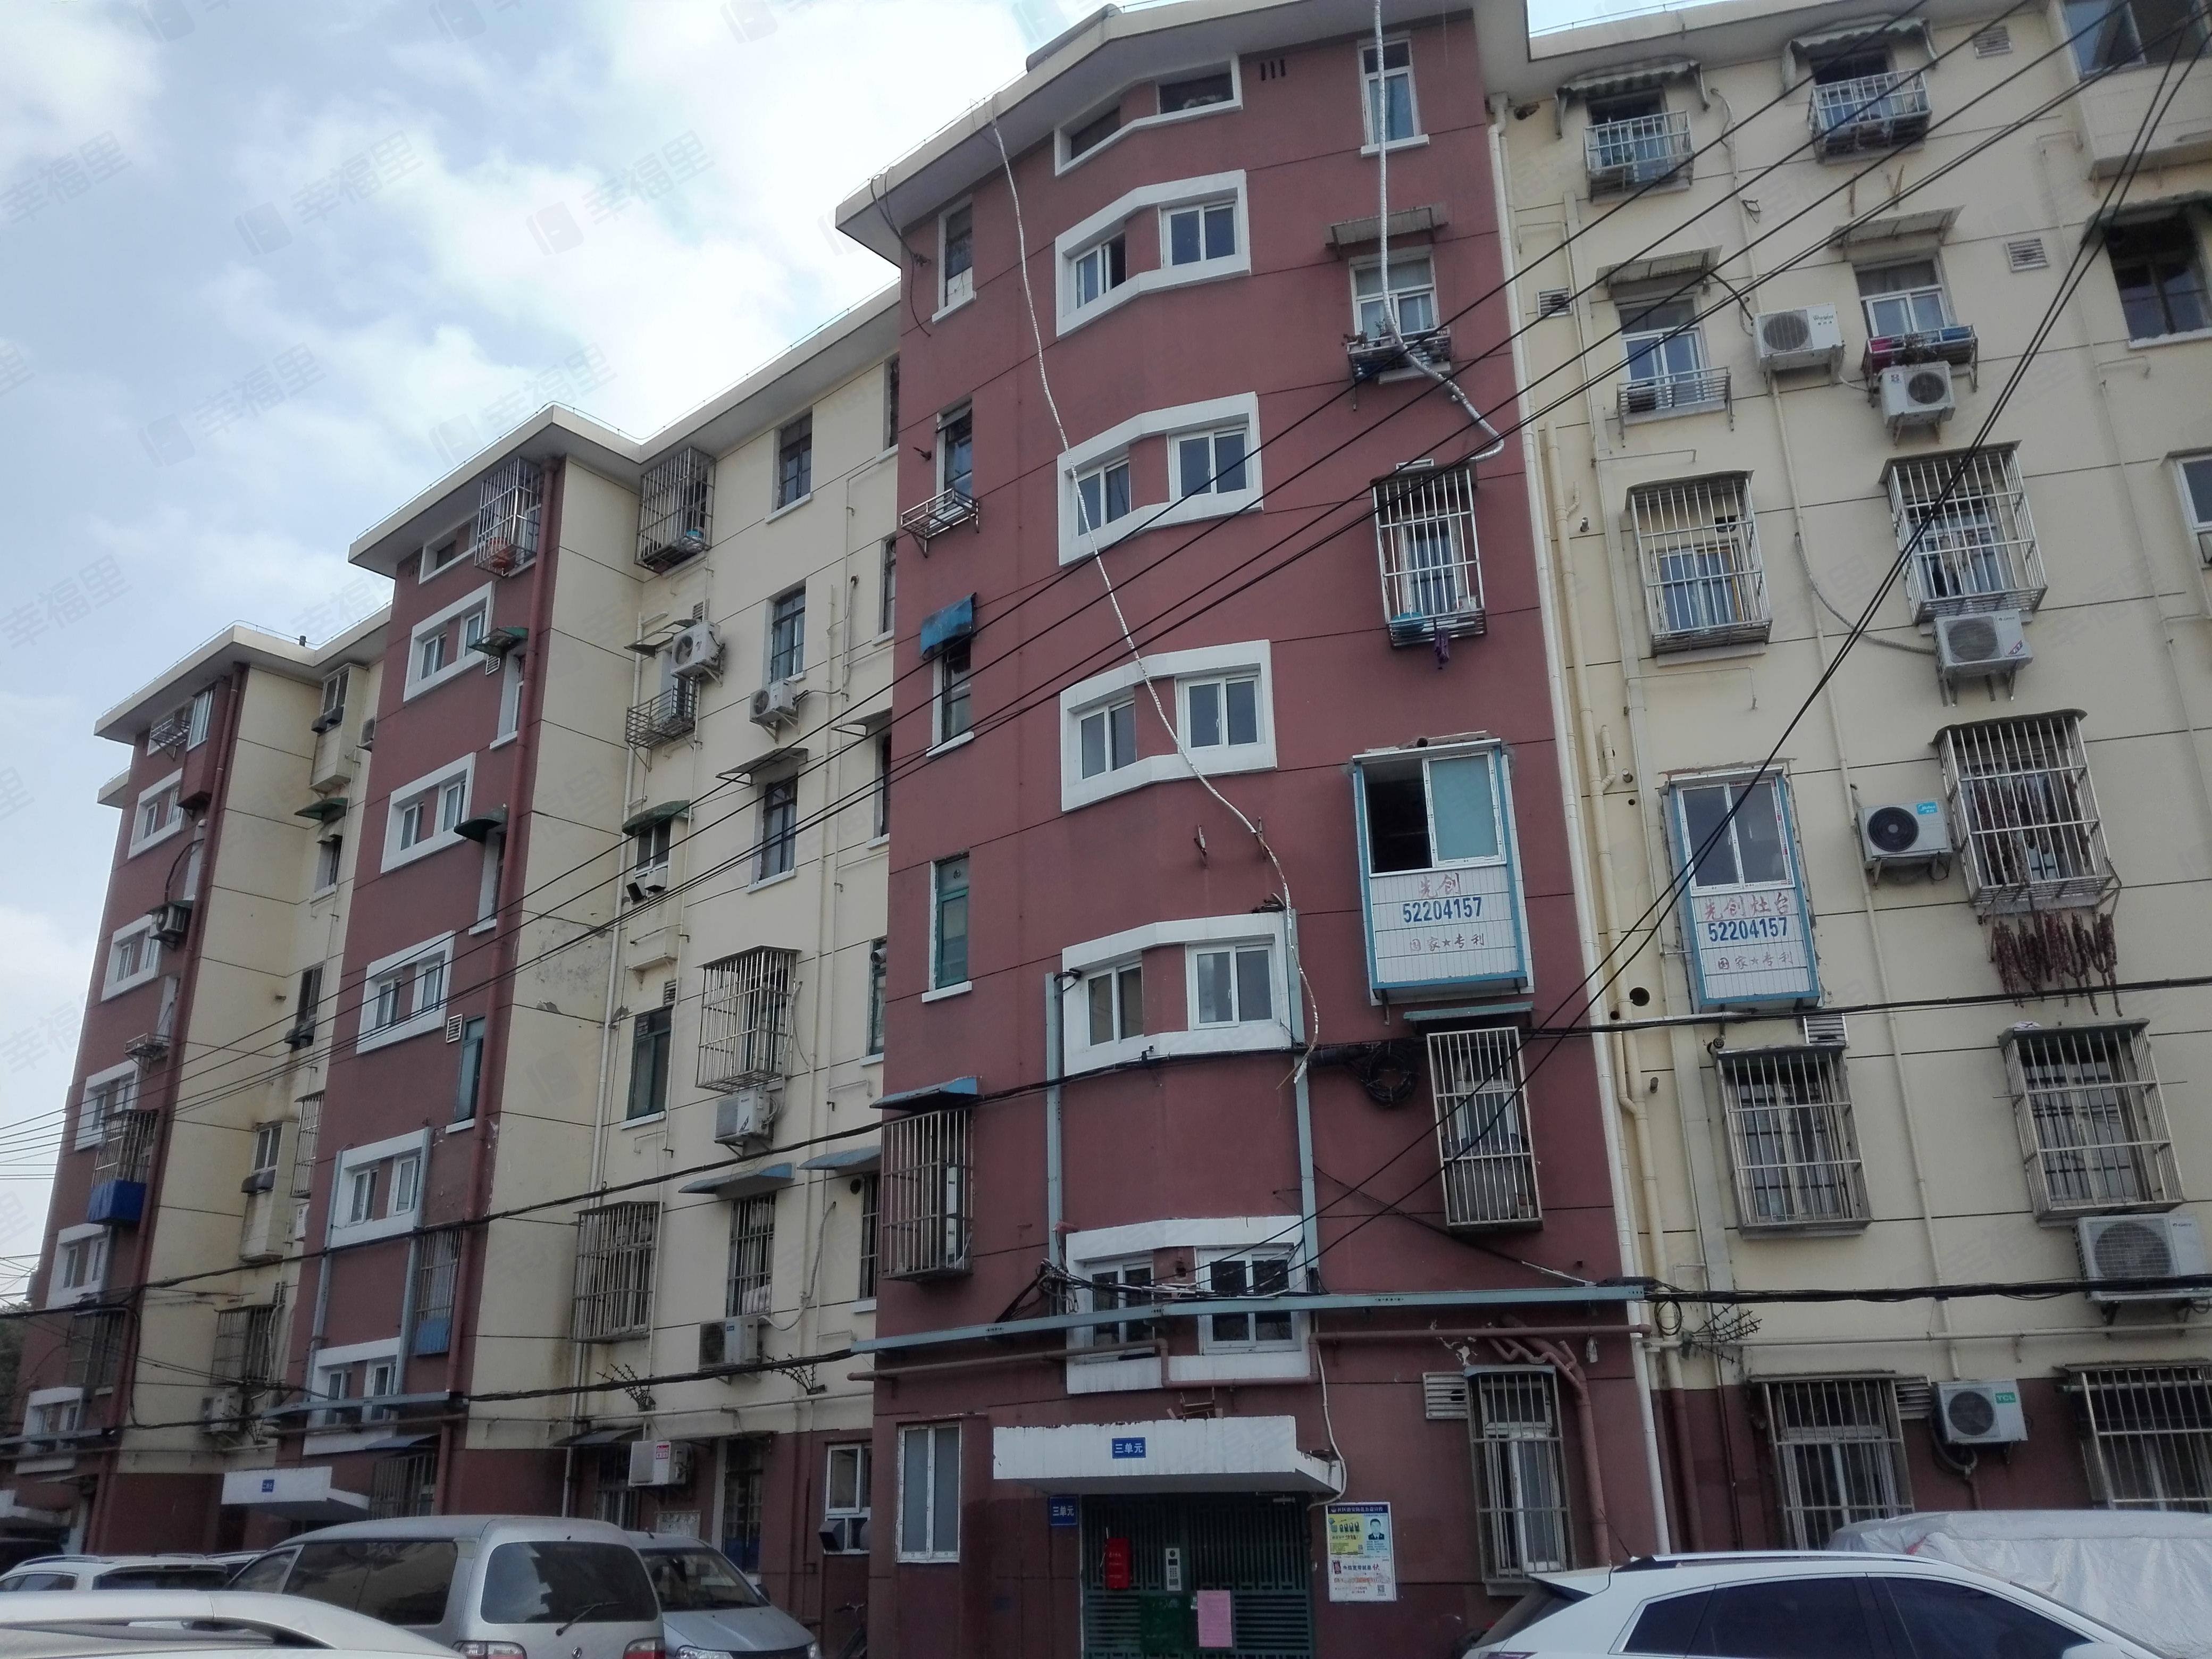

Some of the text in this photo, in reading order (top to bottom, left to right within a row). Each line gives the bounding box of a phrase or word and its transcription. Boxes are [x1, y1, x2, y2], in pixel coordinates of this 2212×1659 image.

[1420, 873, 1461, 899] 先创
[1403, 896, 1482, 923] 52204157
[1705, 892, 1788, 920] 先创灶台
[1708, 917, 1787, 942] 52204157
[1115, 1443, 1143, 1454] 三单元
[1053, 1505, 1074, 1517] 三单元
